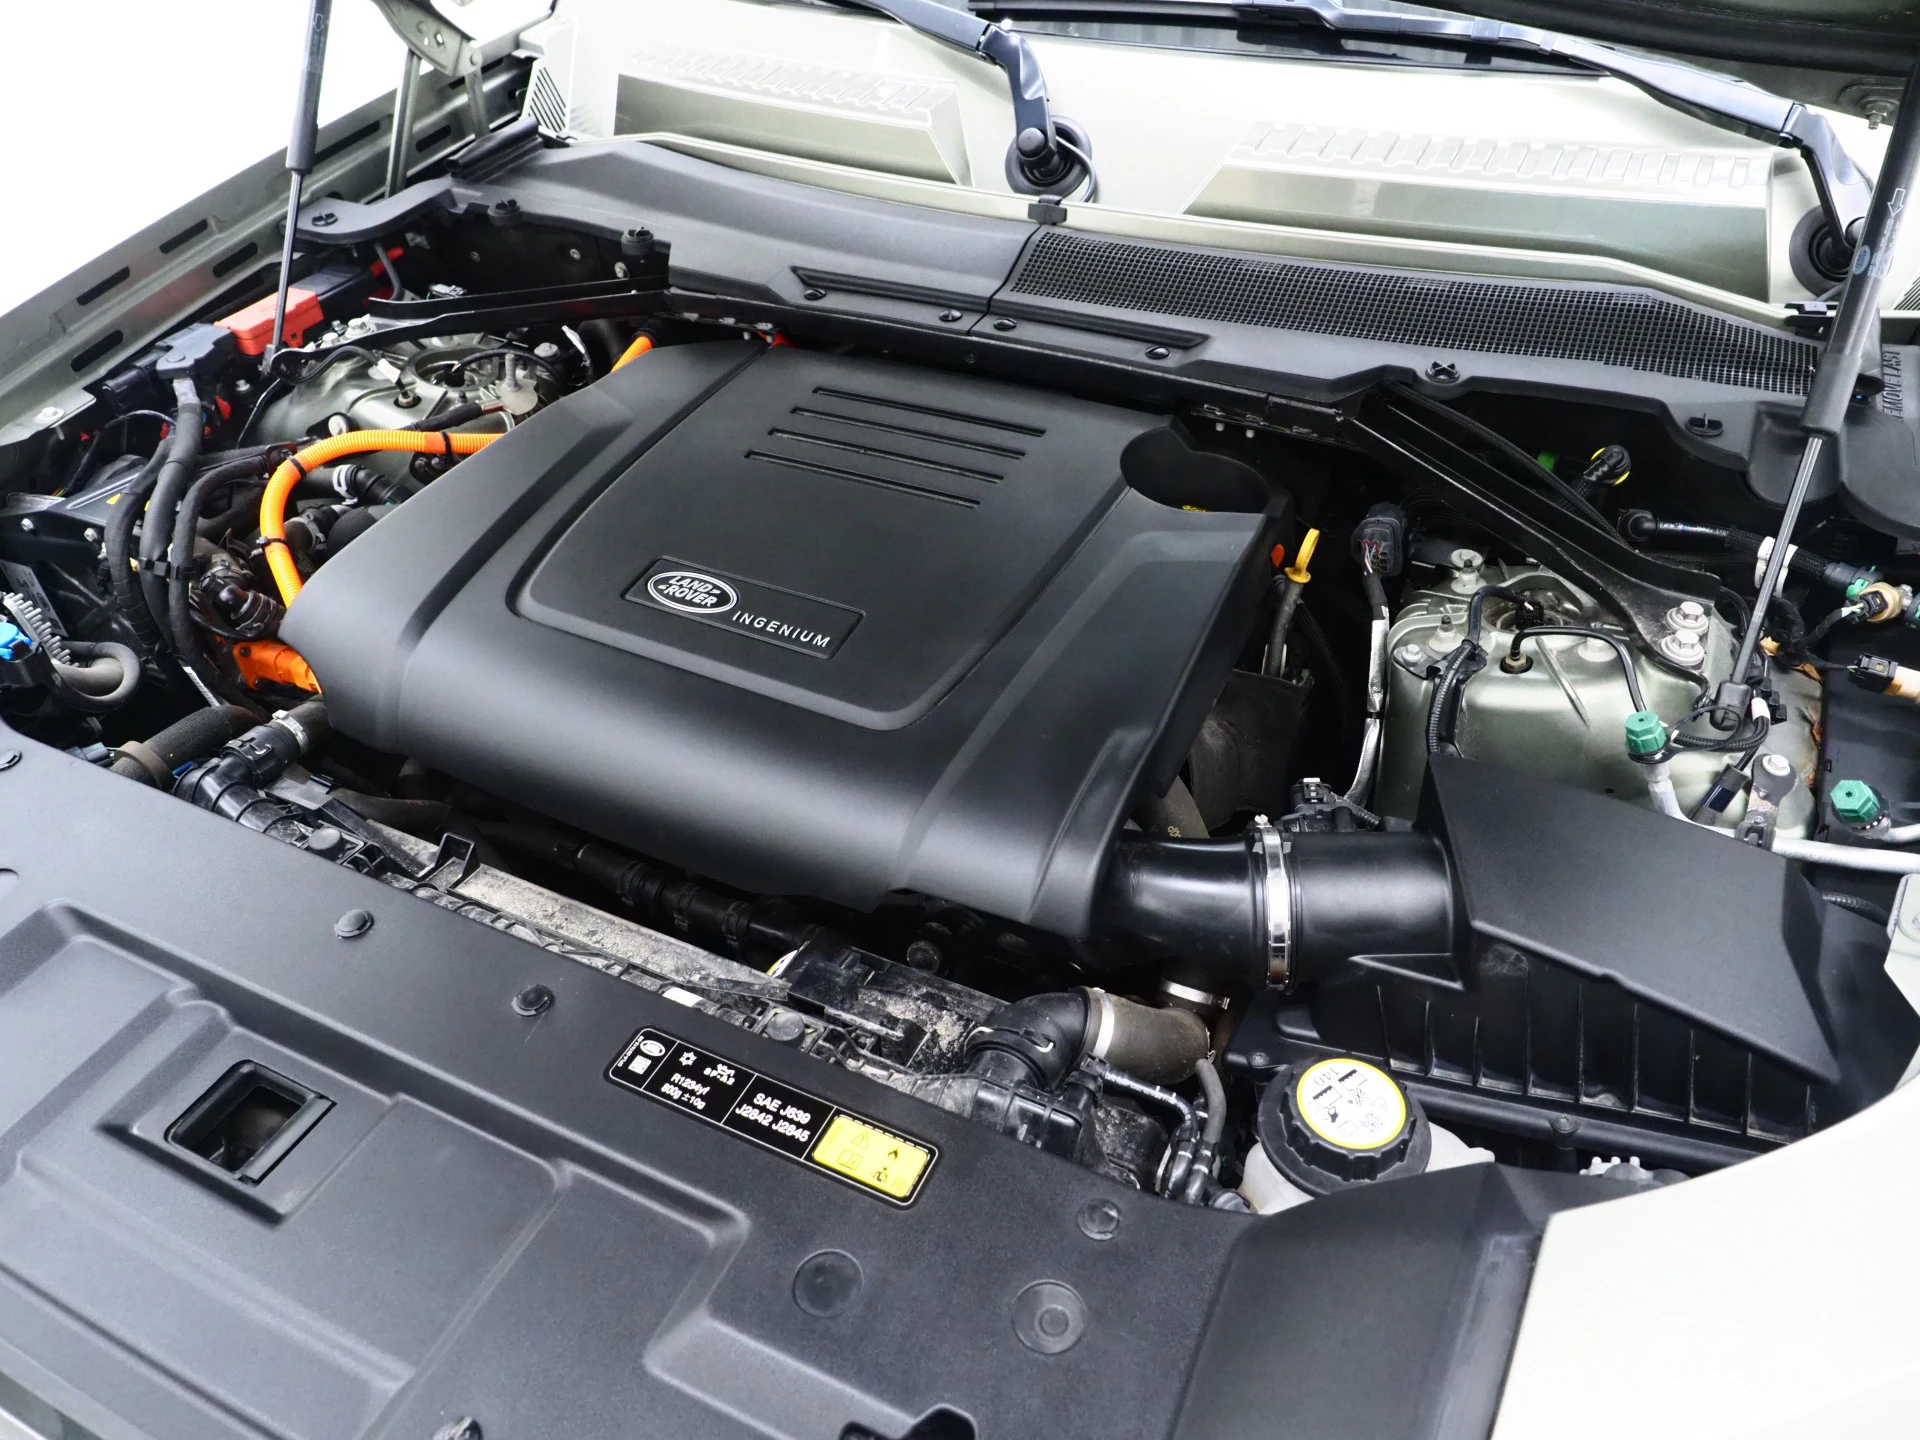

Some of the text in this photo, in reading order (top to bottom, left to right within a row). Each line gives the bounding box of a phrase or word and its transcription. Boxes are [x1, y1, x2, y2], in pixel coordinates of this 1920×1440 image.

[1882, 378, 1904, 422] EMOVE
[663, 585, 718, 607] ROVER
[669, 576, 713, 593] LAND
[732, 610, 831, 648] INGENIUM
[670, 1072, 711, 1095] R1234yf
[734, 1103, 774, 1127] J2842
[771, 1119, 811, 1142] J2845
[753, 1092, 811, 1125] SAE J639
